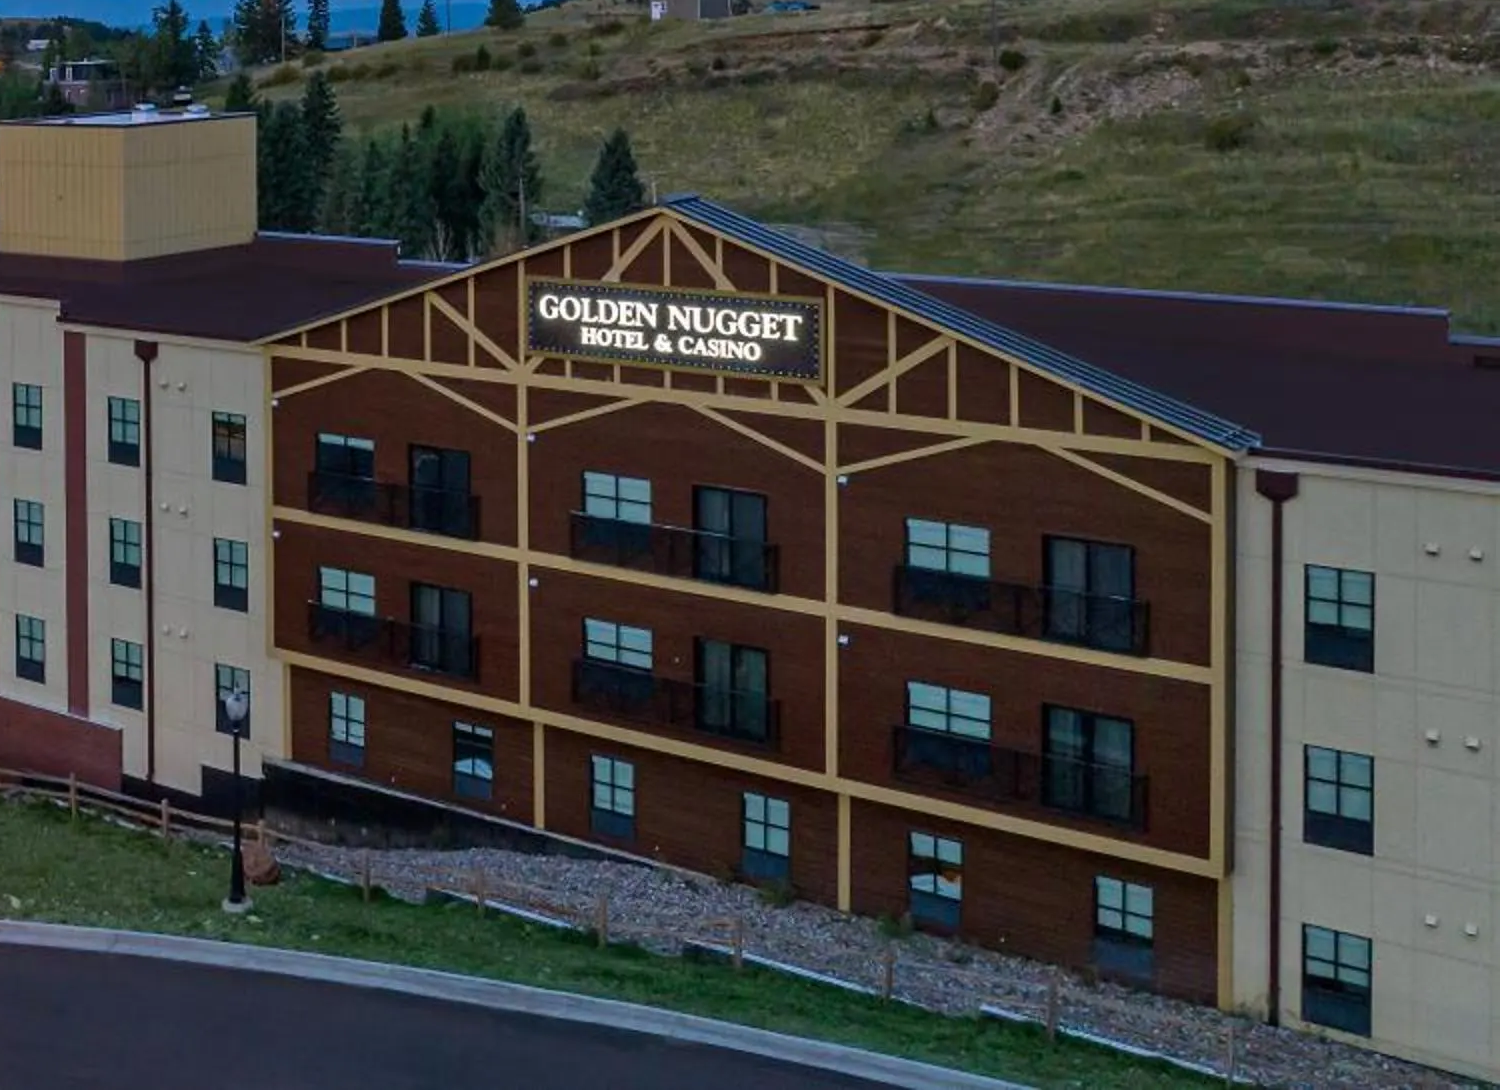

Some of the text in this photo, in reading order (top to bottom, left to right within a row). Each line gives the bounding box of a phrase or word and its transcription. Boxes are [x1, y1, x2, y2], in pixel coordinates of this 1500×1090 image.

[539, 294, 803, 341] GOLDEN NUGGET
[581, 325, 762, 361] HOTEL & CASINO
